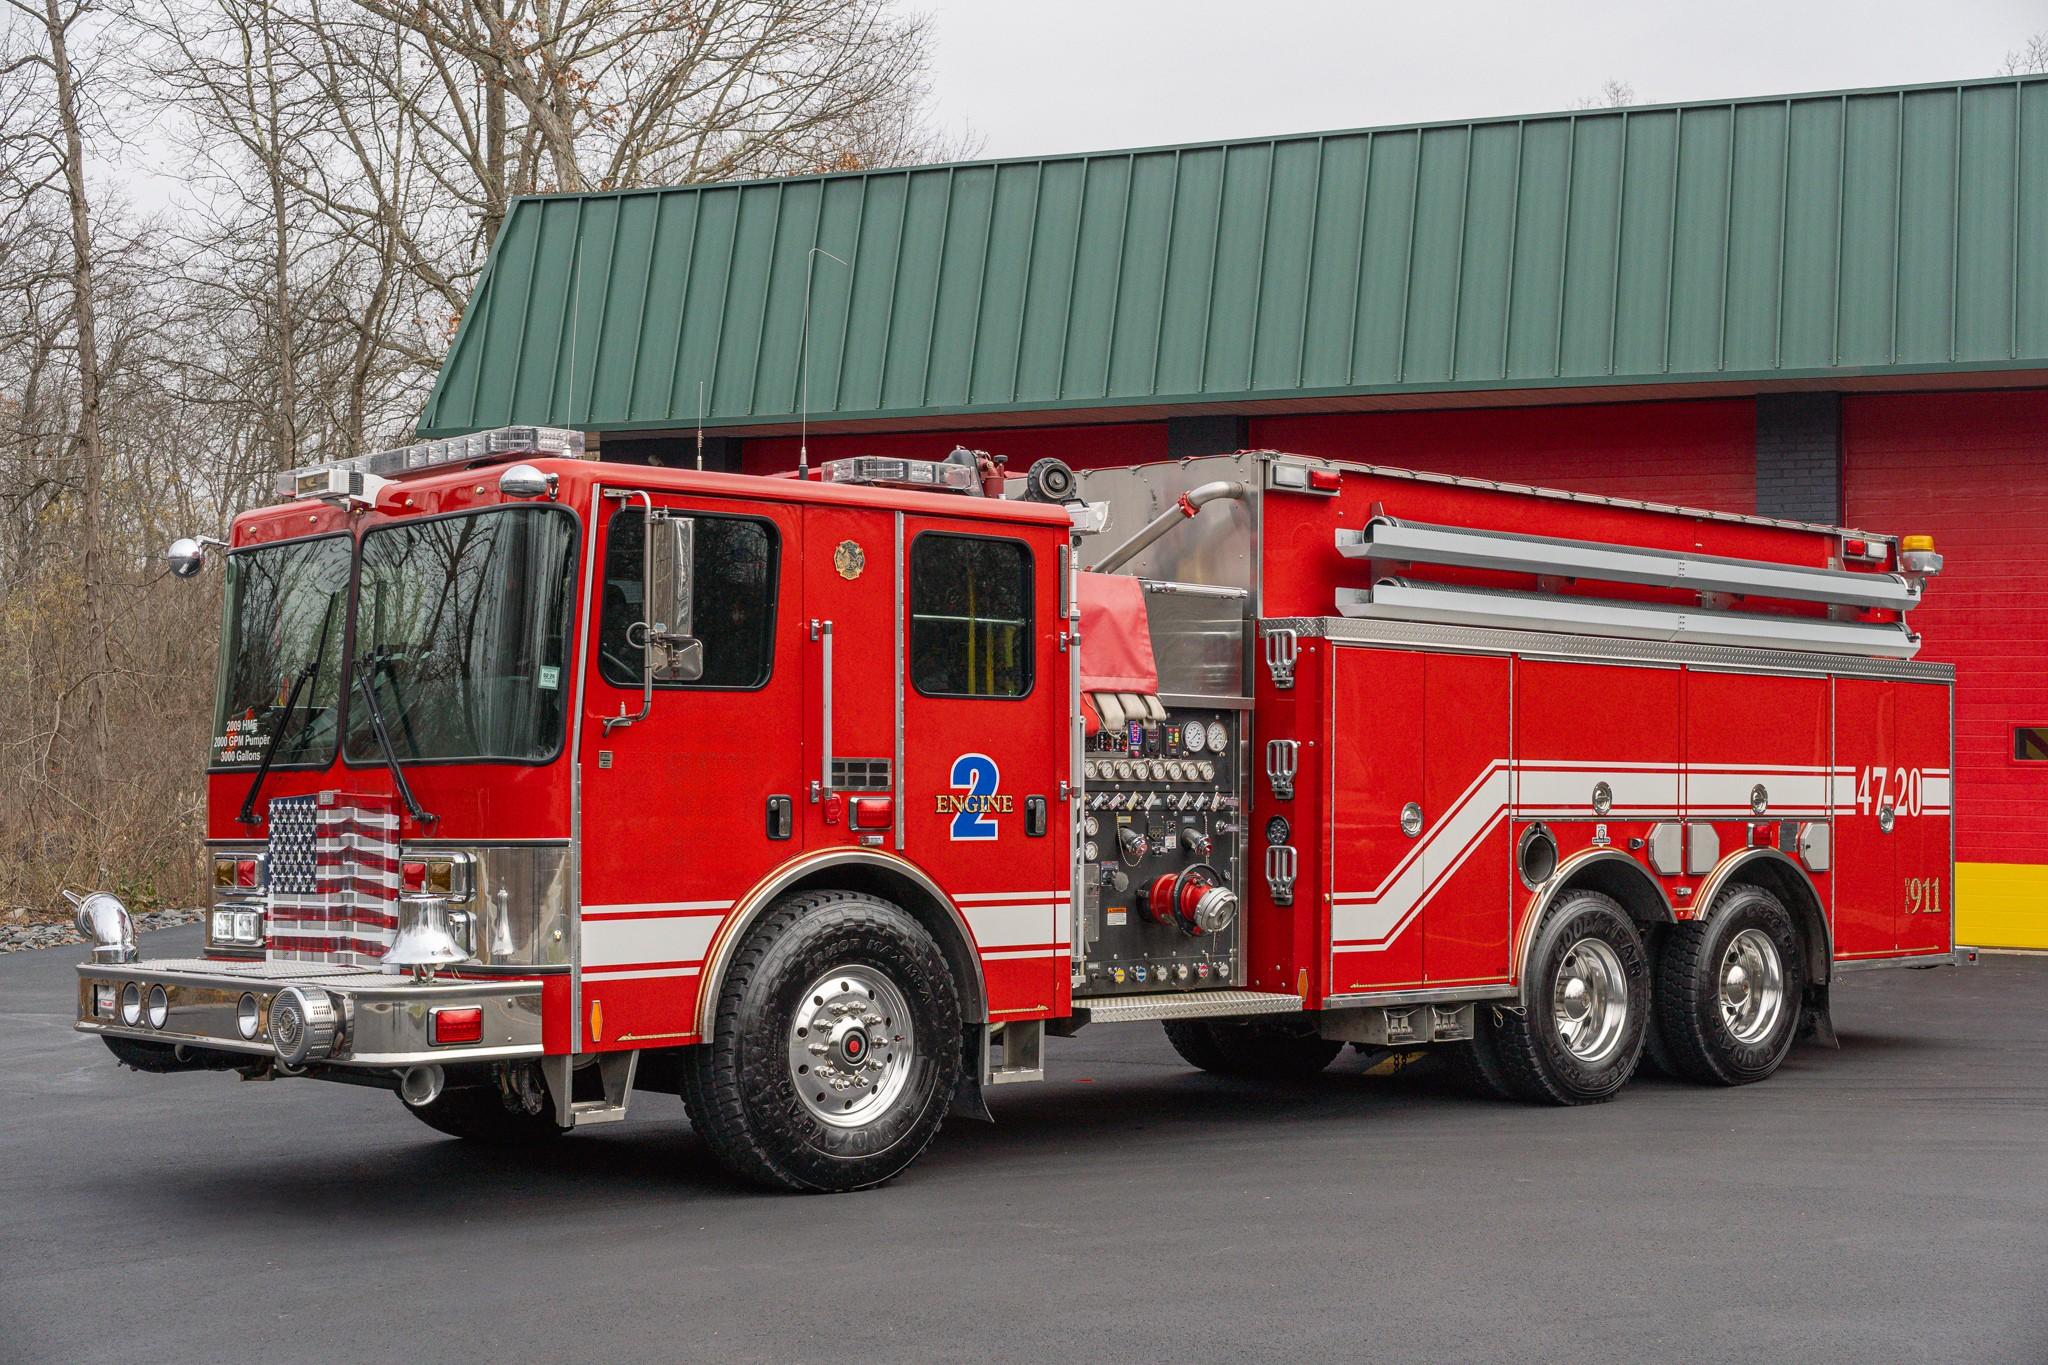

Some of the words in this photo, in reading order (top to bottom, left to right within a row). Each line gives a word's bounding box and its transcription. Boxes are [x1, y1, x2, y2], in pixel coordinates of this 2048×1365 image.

[226, 721, 241, 731] 2009
[242, 719, 258, 731] HME
[214, 736, 228, 747] 2000
[228, 735, 244, 747] GPM
[245, 735, 271, 748] Pumper
[220, 751, 235, 762] 3000
[236, 750, 261, 762] Gallons
[950, 753, 1000, 841] 2
[1857, 765, 1922, 818] 47-20
[935, 795, 1014, 813] ENGINE
[1911, 877, 1942, 914] 911
